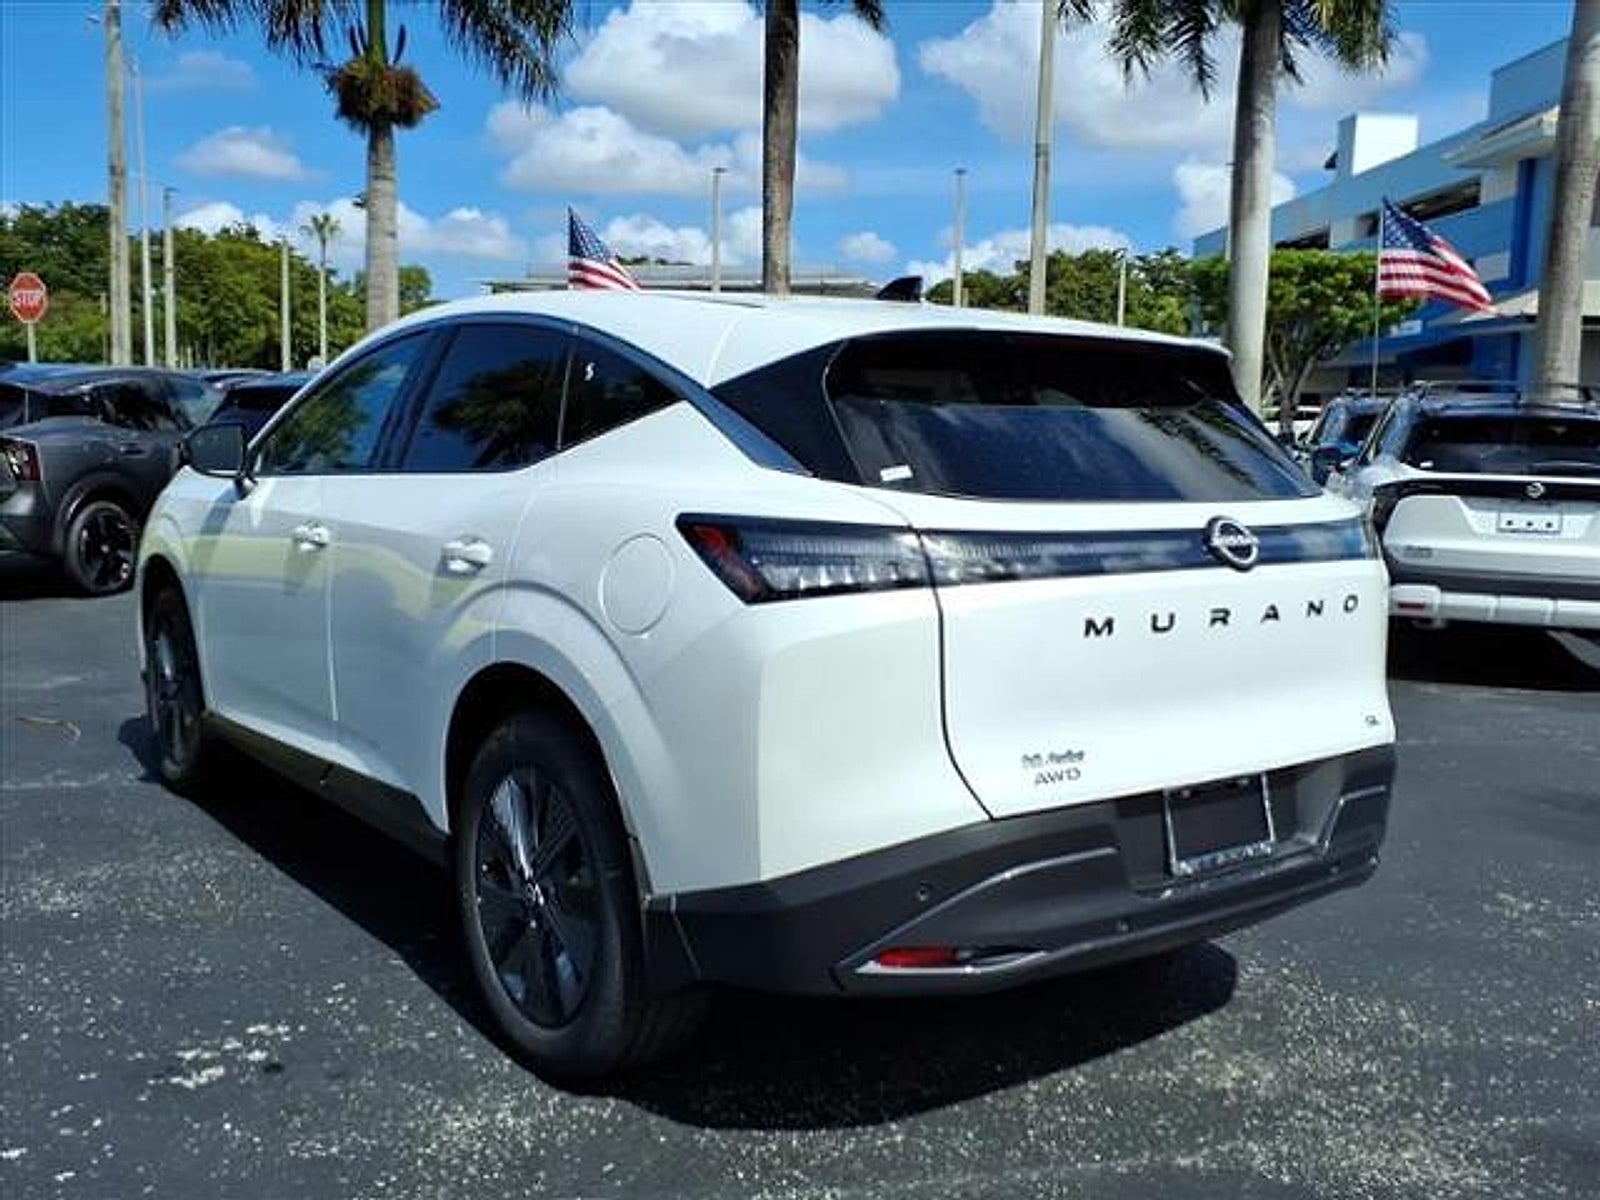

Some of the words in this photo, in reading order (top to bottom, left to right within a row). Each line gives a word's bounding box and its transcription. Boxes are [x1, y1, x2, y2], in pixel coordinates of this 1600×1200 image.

[12, 289, 43, 307] STOP
[1083, 594, 1359, 638] MURANO
[1034, 767, 1081, 785] AWD
